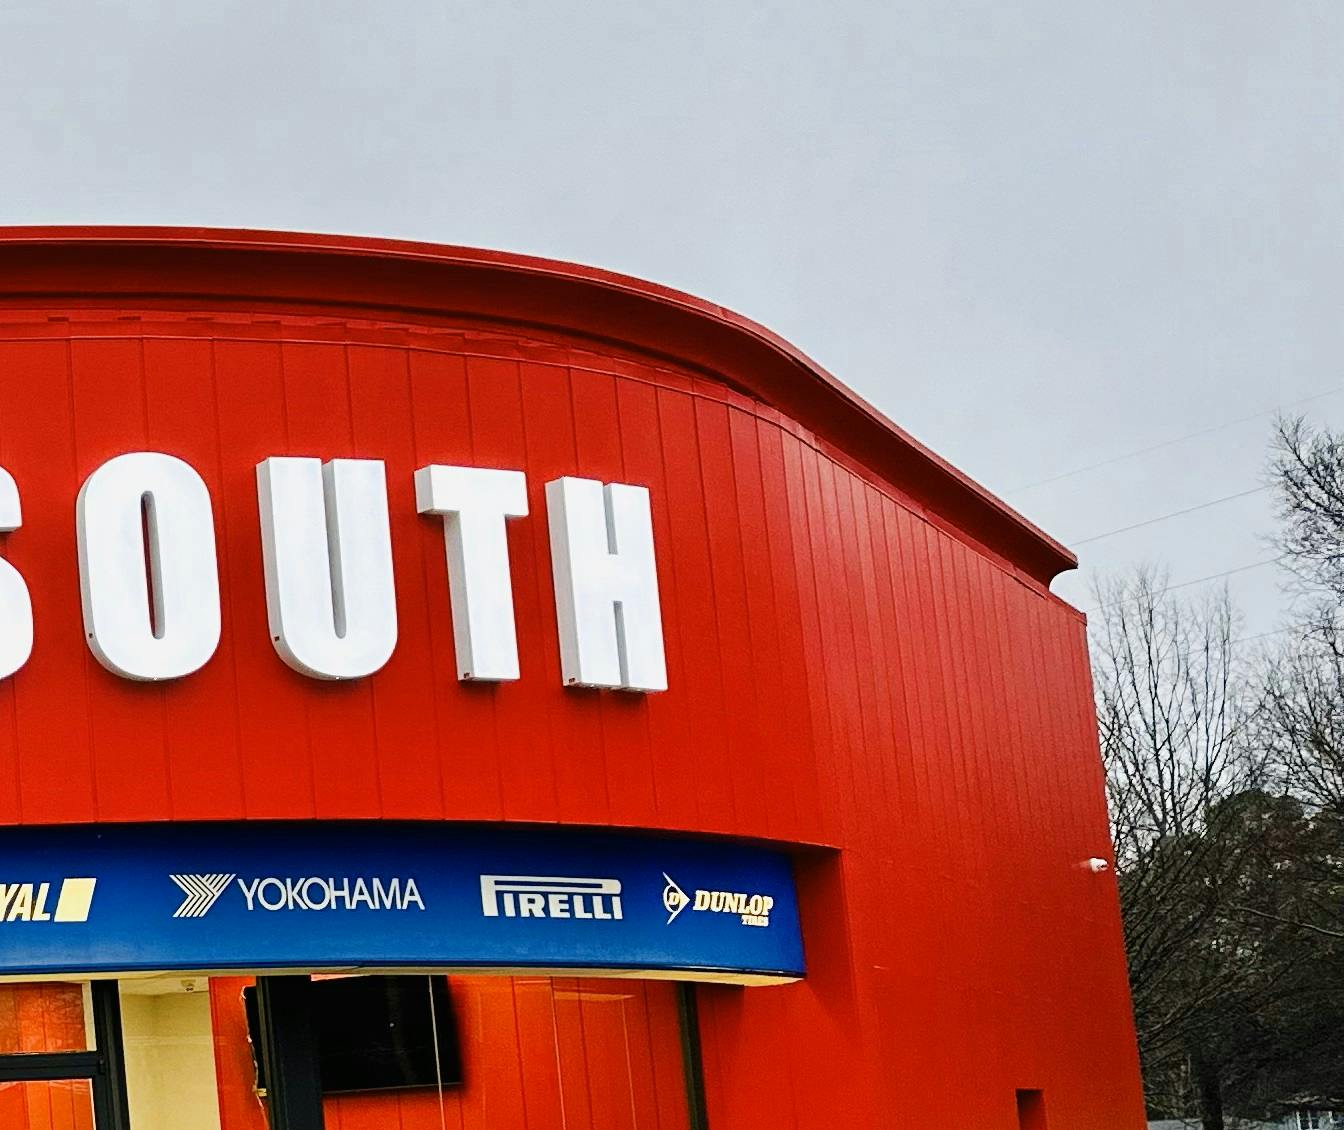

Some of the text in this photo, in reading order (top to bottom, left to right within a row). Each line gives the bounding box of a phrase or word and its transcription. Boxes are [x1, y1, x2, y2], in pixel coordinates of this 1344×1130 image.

[237, 877, 425, 911] YOKOHAMA
[480, 875, 623, 920] PIRELLI
[693, 889, 774, 916] DUNLOP
